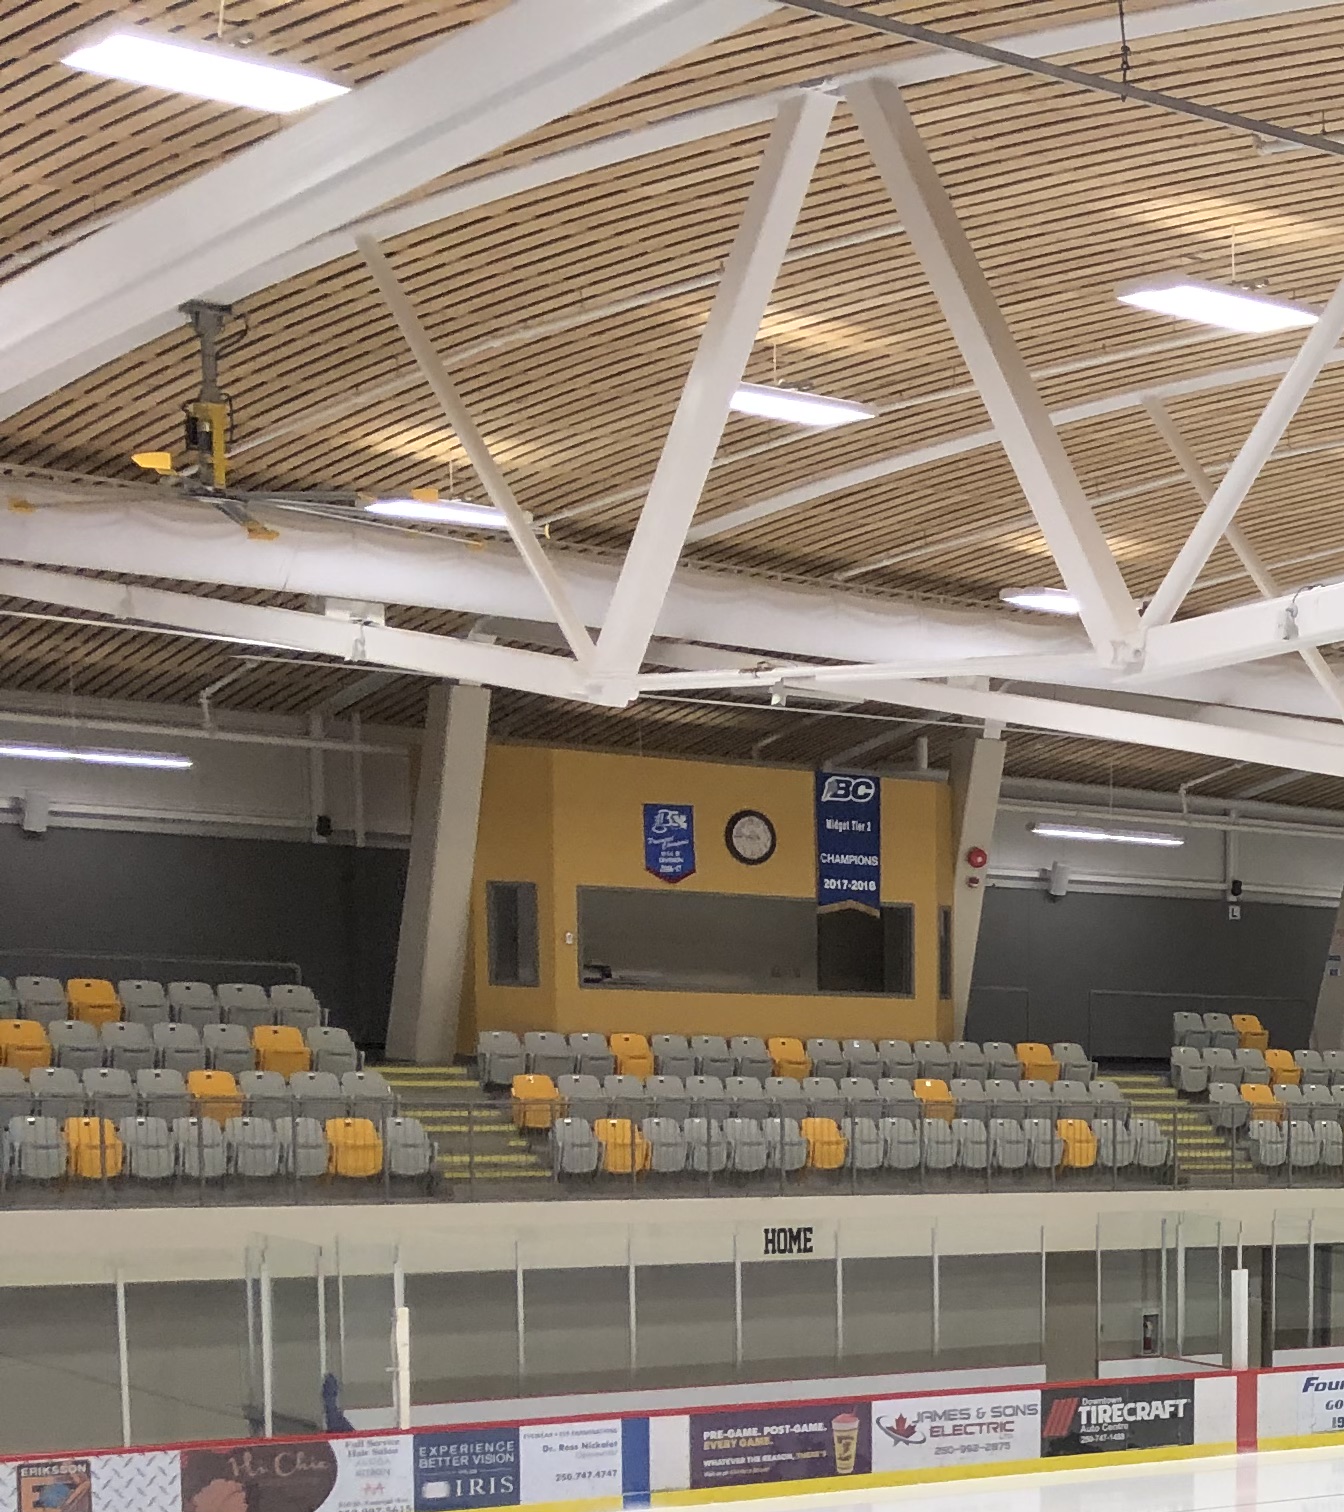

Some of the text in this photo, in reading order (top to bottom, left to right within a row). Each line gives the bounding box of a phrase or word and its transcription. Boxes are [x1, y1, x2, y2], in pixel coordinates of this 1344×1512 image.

[826, 819, 849, 832] Midget
[820, 853, 879, 867] CHAMPIONS
[823, 879, 876, 891] 2017-2018
[763, 1227, 813, 1255] HOME
[1082, 1396, 1122, 1406] Downtown
[912, 1403, 1039, 1424] JAMES & SONS
[1078, 1399, 1189, 1425] TIRECRAFT
[703, 1423, 827, 1440] PRE-GAME. POST-GAME.
[929, 1421, 1015, 1438] ELECTRIC
[1080, 1423, 1101, 1433] Auto
[419, 1440, 515, 1457] EXPERIENCE
[542, 1444, 557, 1453] Dr.
[703, 1436, 773, 1450] EVERY GAME.
[419, 1452, 514, 1468] BETTER VISION
[703, 1456, 746, 1467] WHATEVER
[20, 1464, 87, 1478] ERIKSSON
[455, 1475, 514, 1497] IRIS
